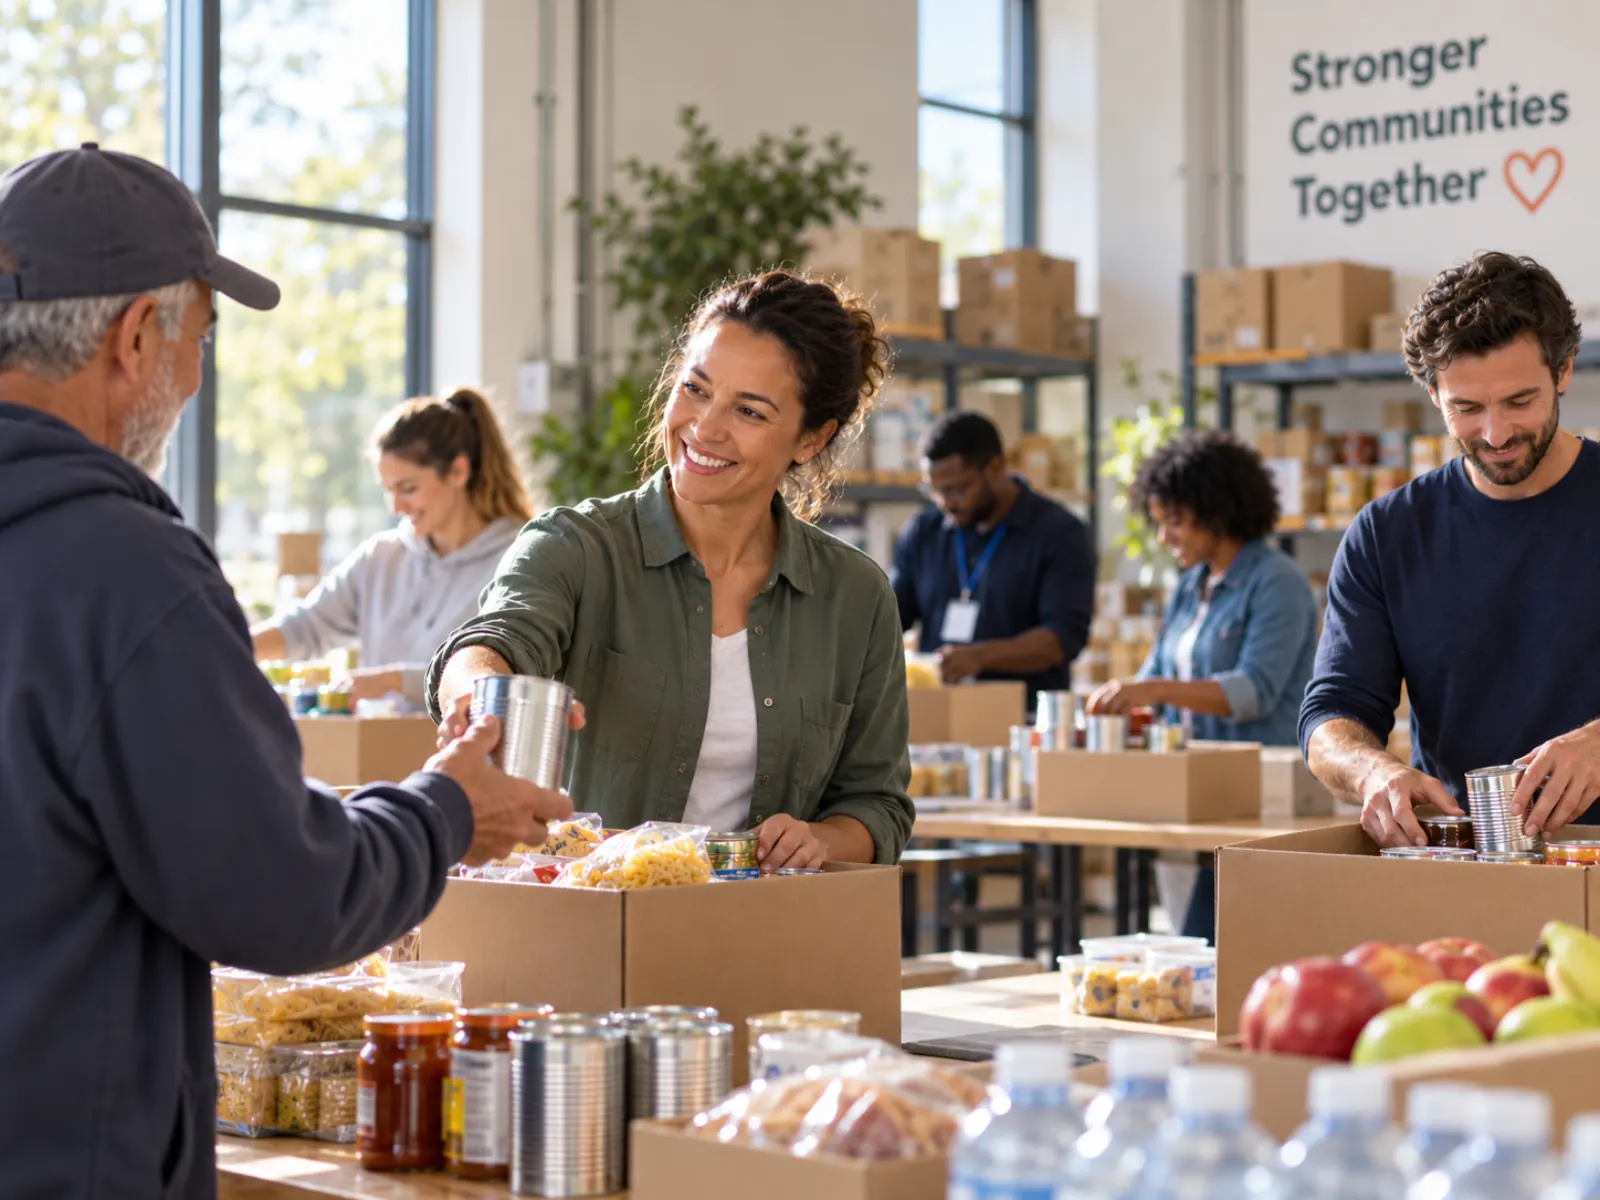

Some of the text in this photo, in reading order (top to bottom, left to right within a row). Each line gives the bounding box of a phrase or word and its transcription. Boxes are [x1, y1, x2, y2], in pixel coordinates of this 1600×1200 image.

[1291, 35, 1488, 94] Stronger
[1291, 85, 1570, 155] Communities
[1291, 162, 1488, 224] Together
